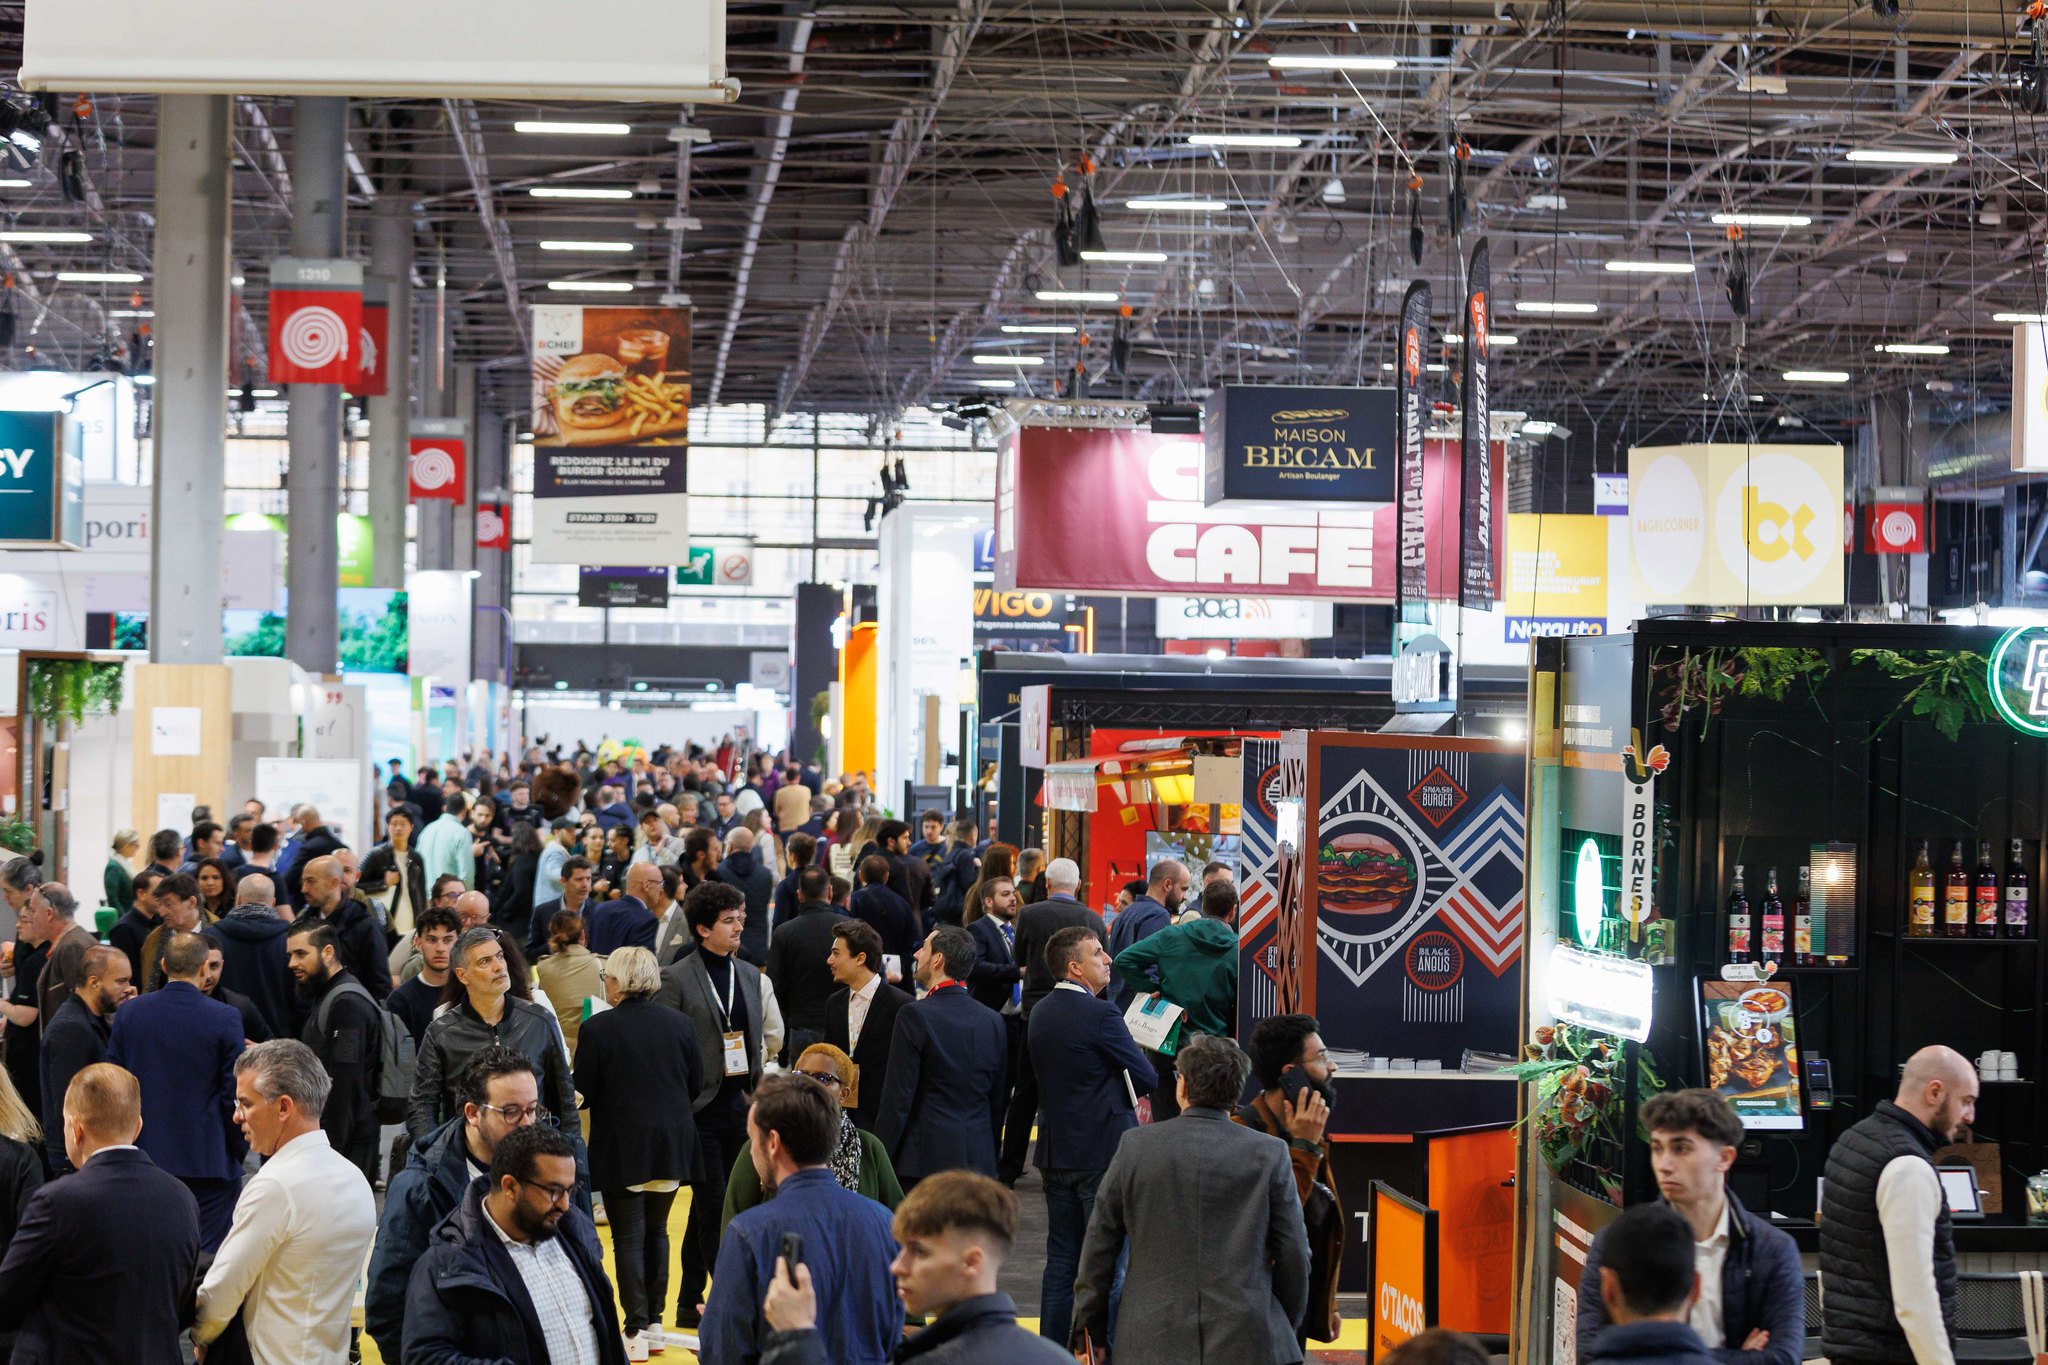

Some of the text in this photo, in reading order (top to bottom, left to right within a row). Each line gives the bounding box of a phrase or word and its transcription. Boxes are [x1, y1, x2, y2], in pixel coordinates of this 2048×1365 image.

[1274, 428, 1346, 443] MAISON
[550, 456, 615, 466] REJOIGNEZ
[615, 457, 630, 466] LE
[652, 457, 670, 467] DU
[1242, 443, 1377, 470] BÉCAM
[557, 466, 663, 476] BURGER GOURMET
[1279, 471, 1341, 482] Artisan Boulanger
[568, 513, 603, 522] STAND
[1637, 517, 1700, 533] BAGELCORNER
[0, 603, 47, 632] ris
[1014, 621, 1060, 630] automobiles
[1508, 620, 1603, 640] Norauto
[1422, 785, 1453, 794] SMASH
[1422, 793, 1453, 807] BURGER
[1630, 803, 1646, 911] BORNES
[1419, 947, 1450, 956] BLACK
[1417, 956, 1450, 973] ANGUS
[1381, 1281, 1424, 1338] O'TACOS
